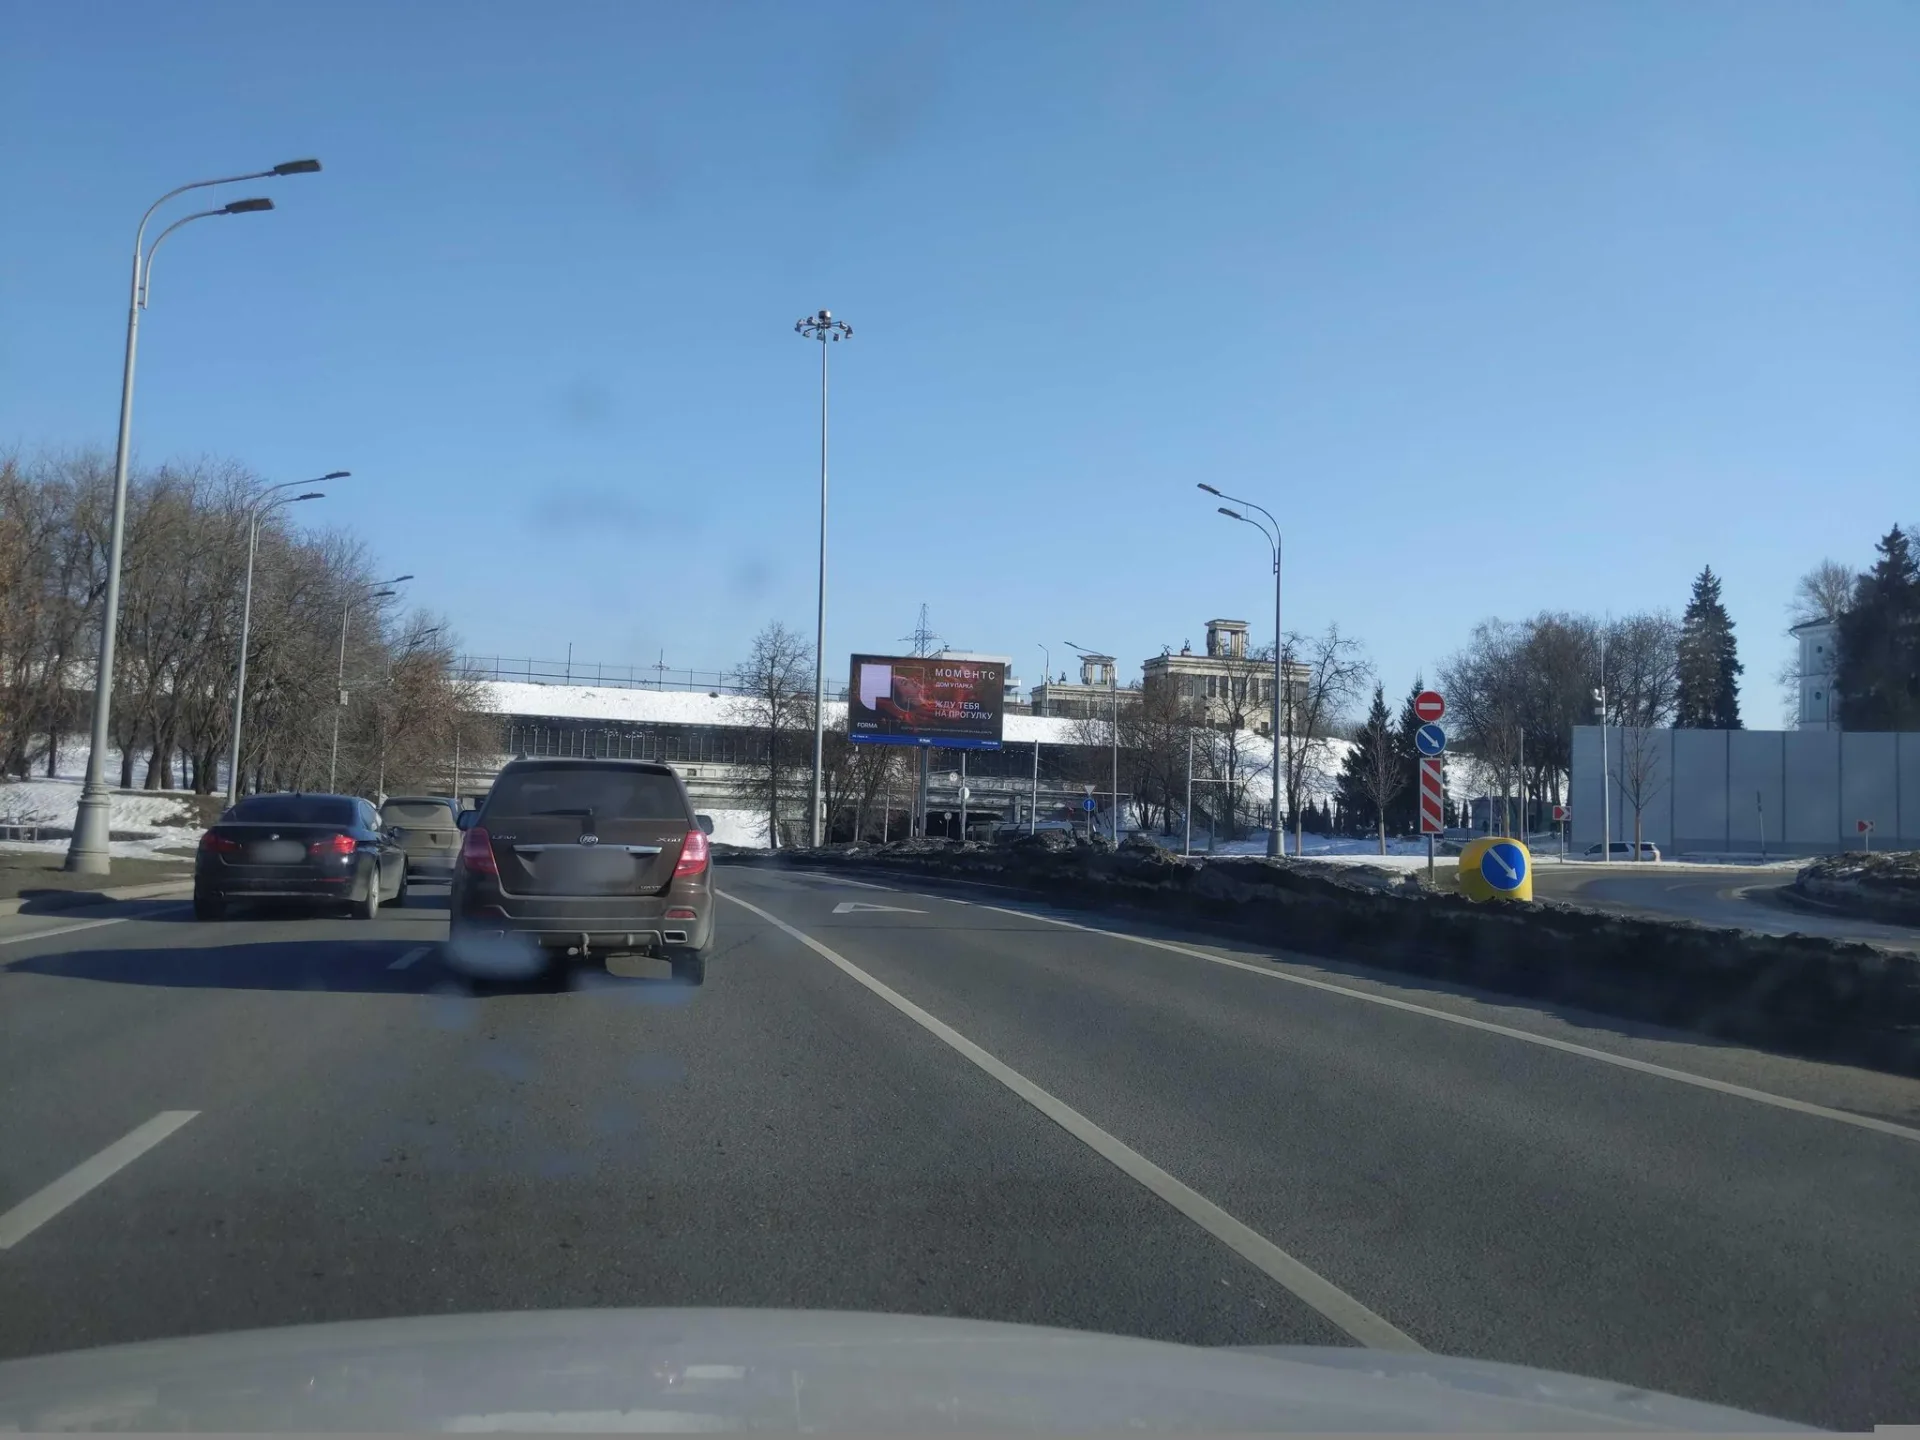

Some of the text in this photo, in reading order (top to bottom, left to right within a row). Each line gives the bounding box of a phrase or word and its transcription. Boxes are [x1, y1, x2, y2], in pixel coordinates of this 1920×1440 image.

[935, 700, 980, 710] ЖДУ ТЕБЯ
[948, 710, 993, 720] ПРОГУЛКУ
